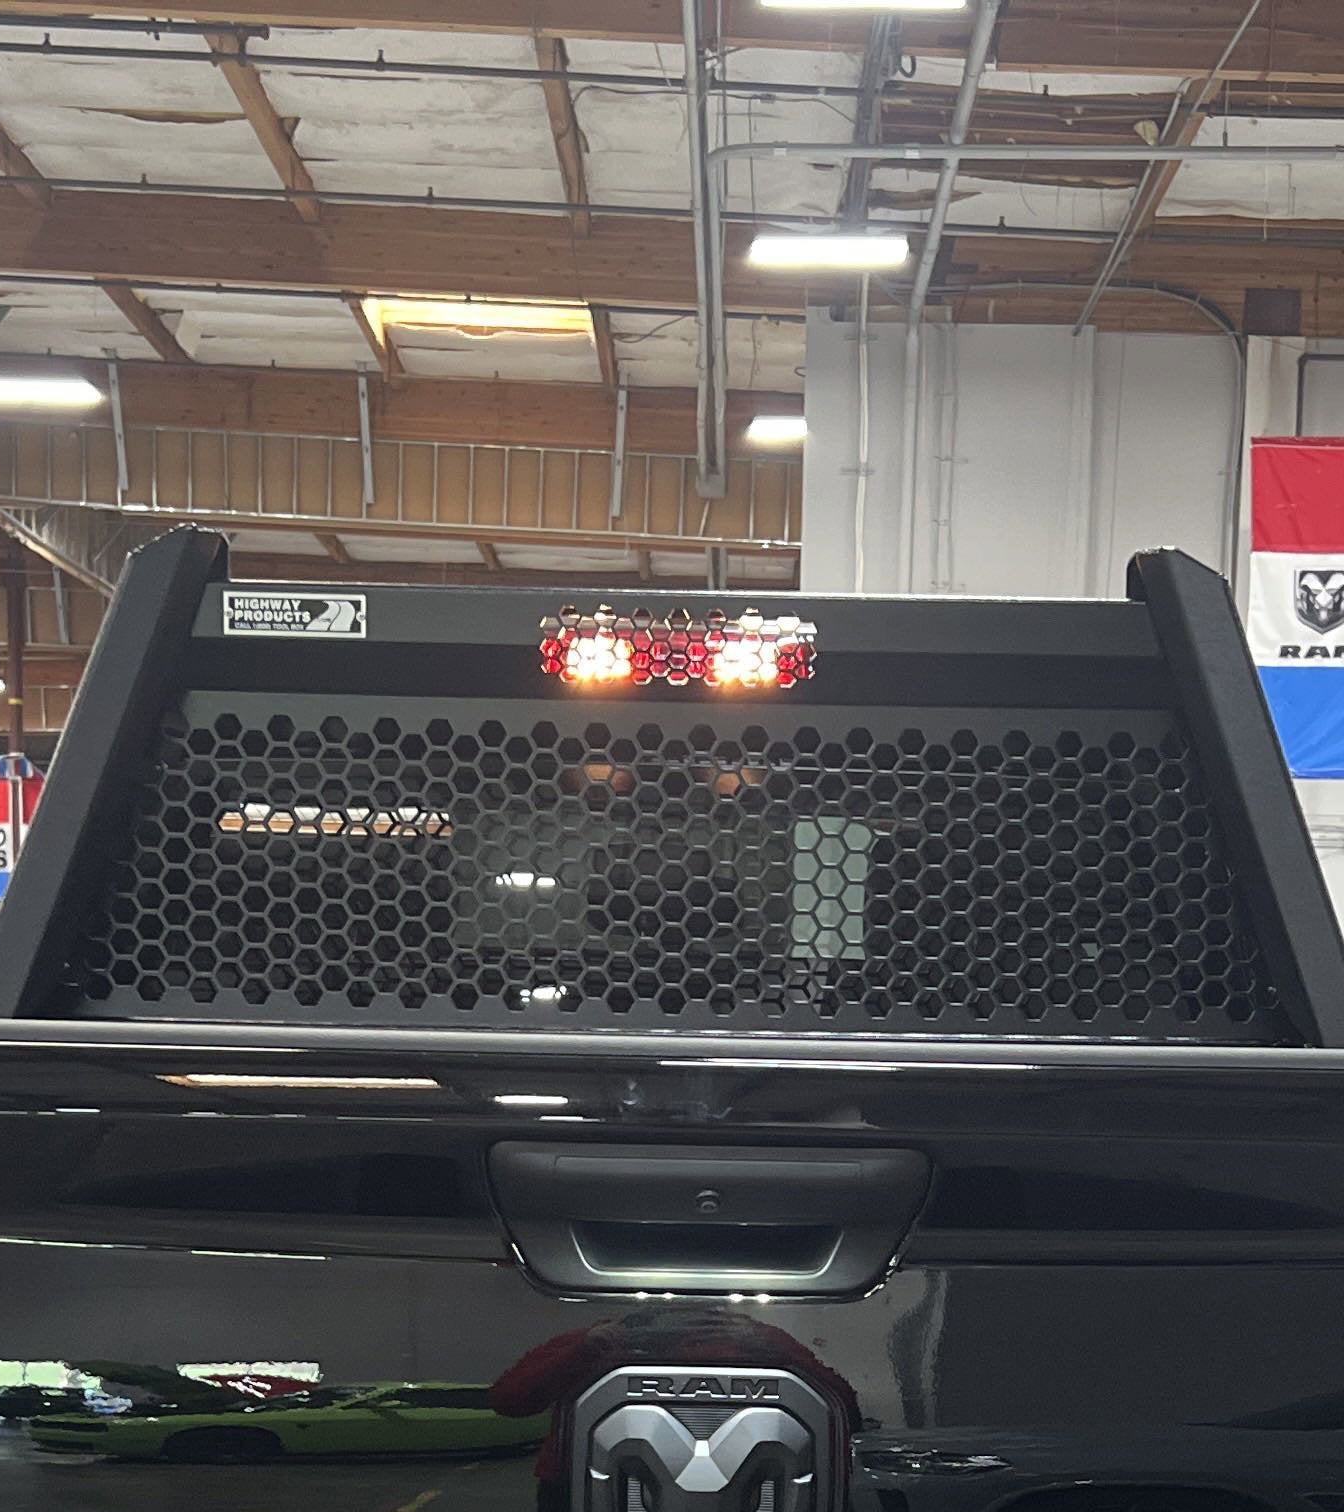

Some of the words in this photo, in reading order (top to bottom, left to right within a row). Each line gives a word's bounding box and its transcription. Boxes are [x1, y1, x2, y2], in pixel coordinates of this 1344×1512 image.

[234, 598, 302, 611] HIGHWAY
[234, 610, 311, 622] PRODUCTS
[626, 1376, 780, 1399] RAM
